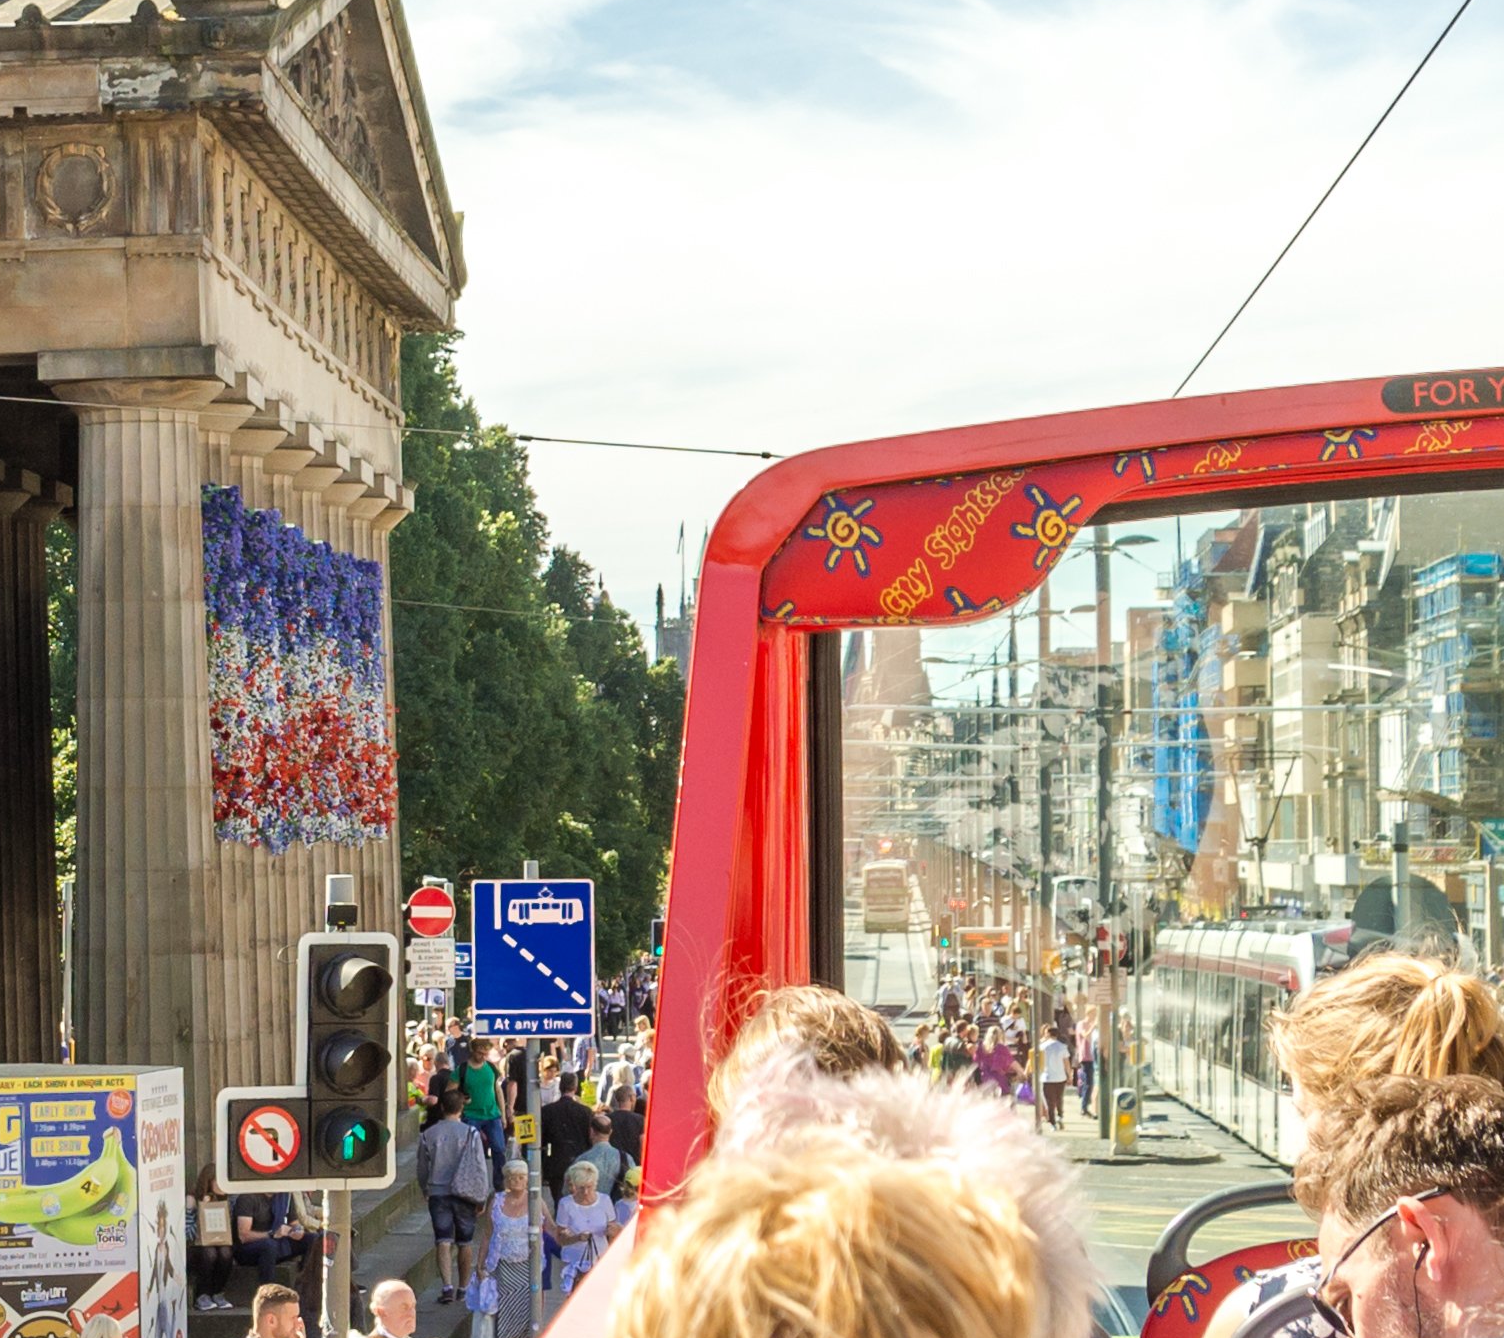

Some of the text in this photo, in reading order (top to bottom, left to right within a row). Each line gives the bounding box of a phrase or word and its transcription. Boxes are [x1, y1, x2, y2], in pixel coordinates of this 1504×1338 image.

[1413, 378, 1479, 408] FOR
[880, 558, 934, 618] City
[494, 1018, 573, 1032] At any time
[23, 1080, 42, 1089] EACH
[45, 1079, 67, 1088] SHOW
[105, 1078, 125, 1087] ACTS
[34, 1103, 87, 1117] EARLY SHOW
[35, 1140, 82, 1153] LATE SHOW
[96, 1233, 126, 1244] Tonic
